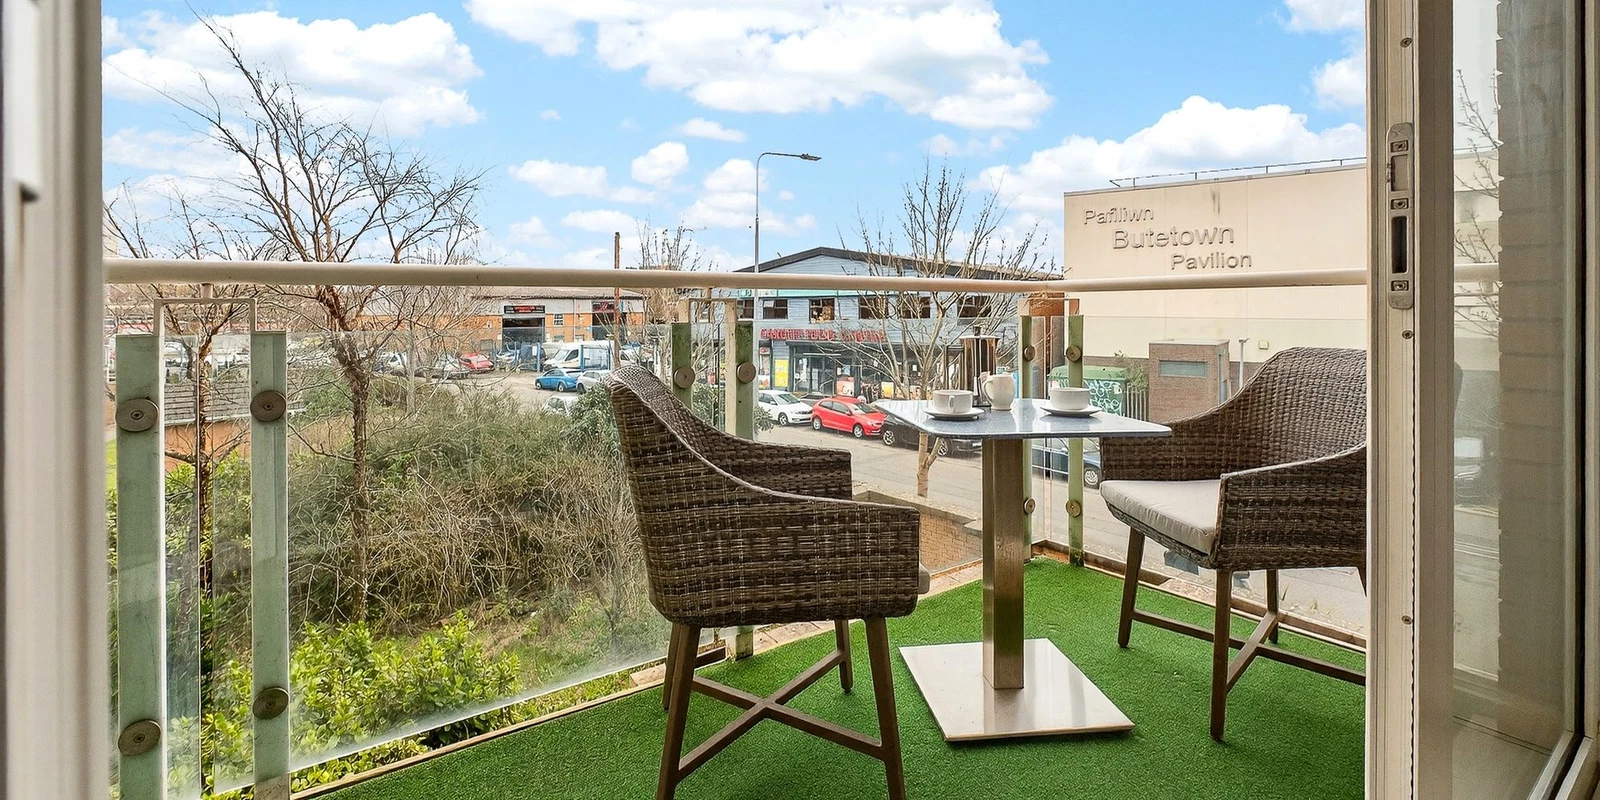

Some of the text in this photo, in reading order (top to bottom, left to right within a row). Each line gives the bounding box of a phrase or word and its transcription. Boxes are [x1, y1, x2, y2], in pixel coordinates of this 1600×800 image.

[1083, 207, 1154, 225] Pafiliwn
[1112, 225, 1235, 250] Butetown
[1170, 251, 1252, 270] Pavilion
